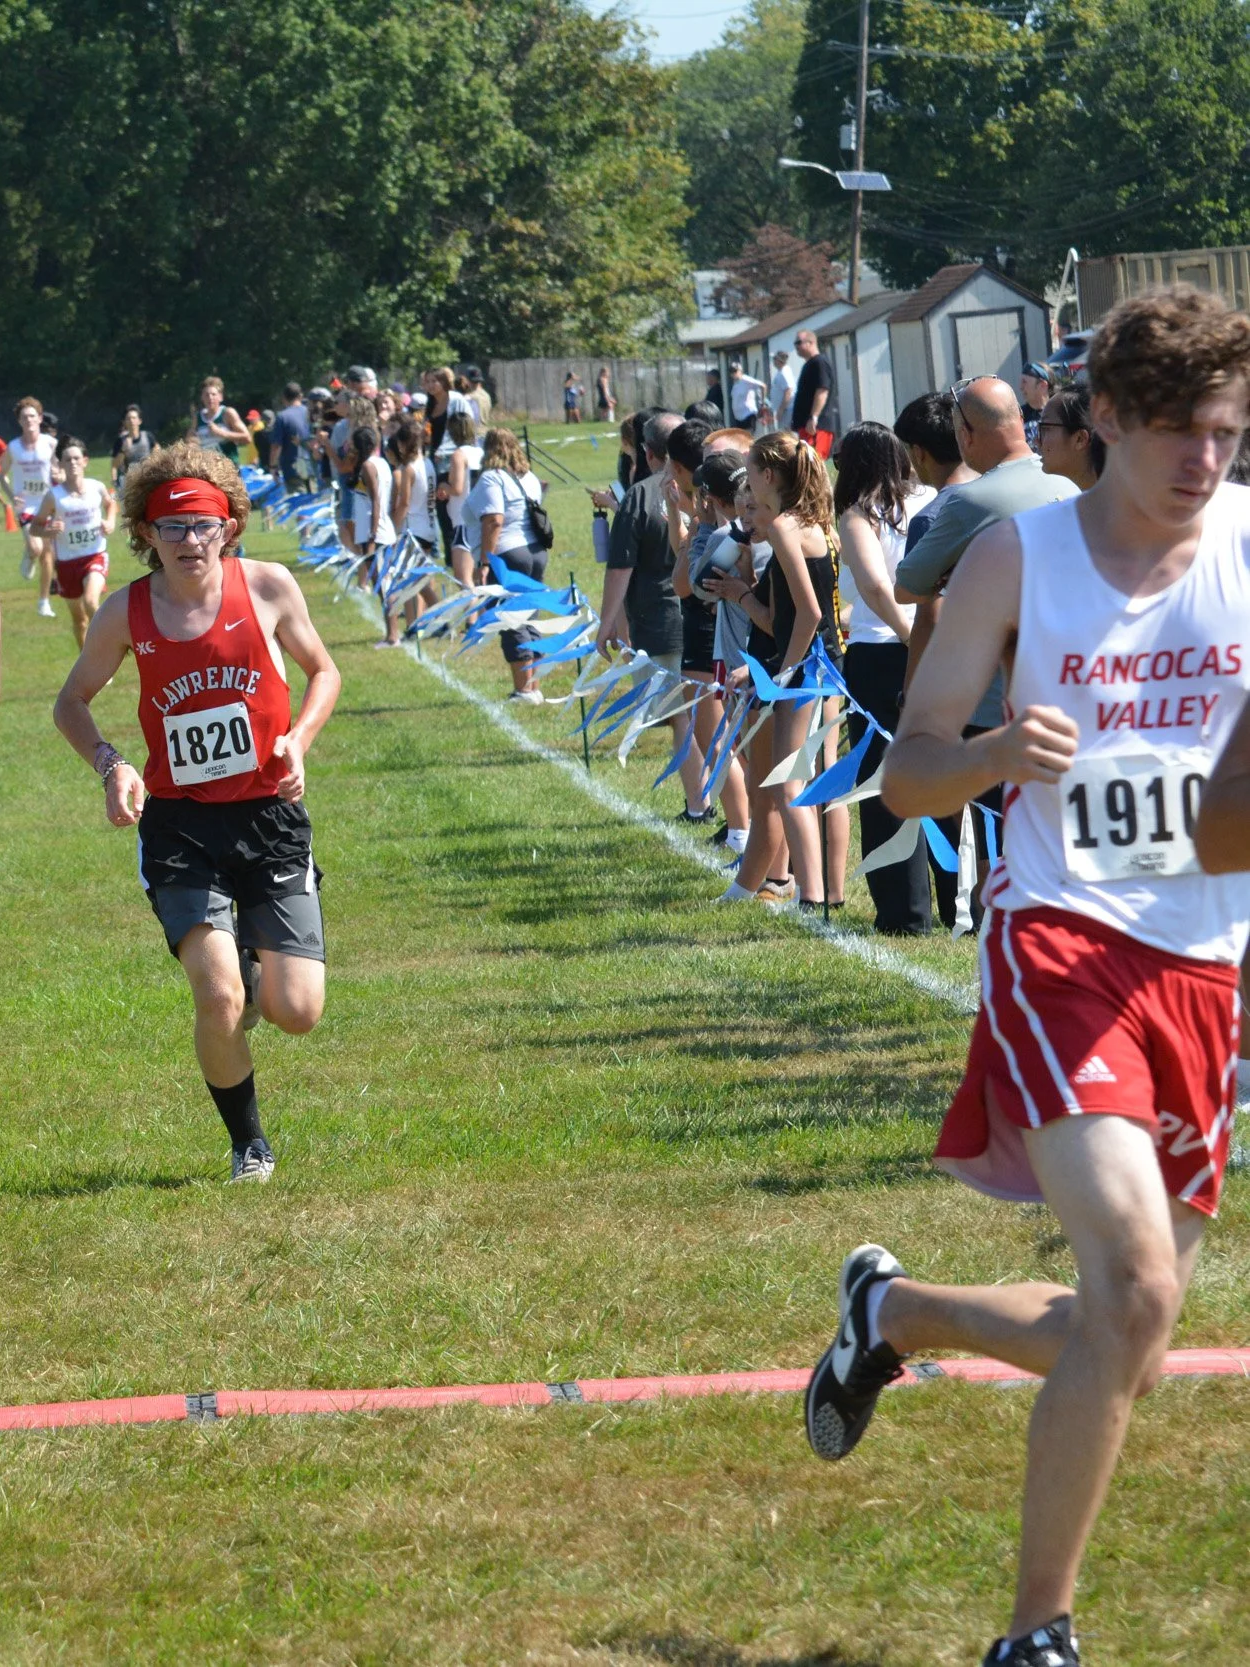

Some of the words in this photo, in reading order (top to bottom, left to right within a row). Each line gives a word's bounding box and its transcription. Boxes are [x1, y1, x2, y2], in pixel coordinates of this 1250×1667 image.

[69, 530, 96, 544] 1923
[1059, 644, 1243, 685] RANCOCAS
[151, 666, 262, 715] LAWRENCE
[1096, 694, 1219, 731] VALLEY
[169, 716, 251, 768] 1820
[1068, 773, 1208, 849] 1910
